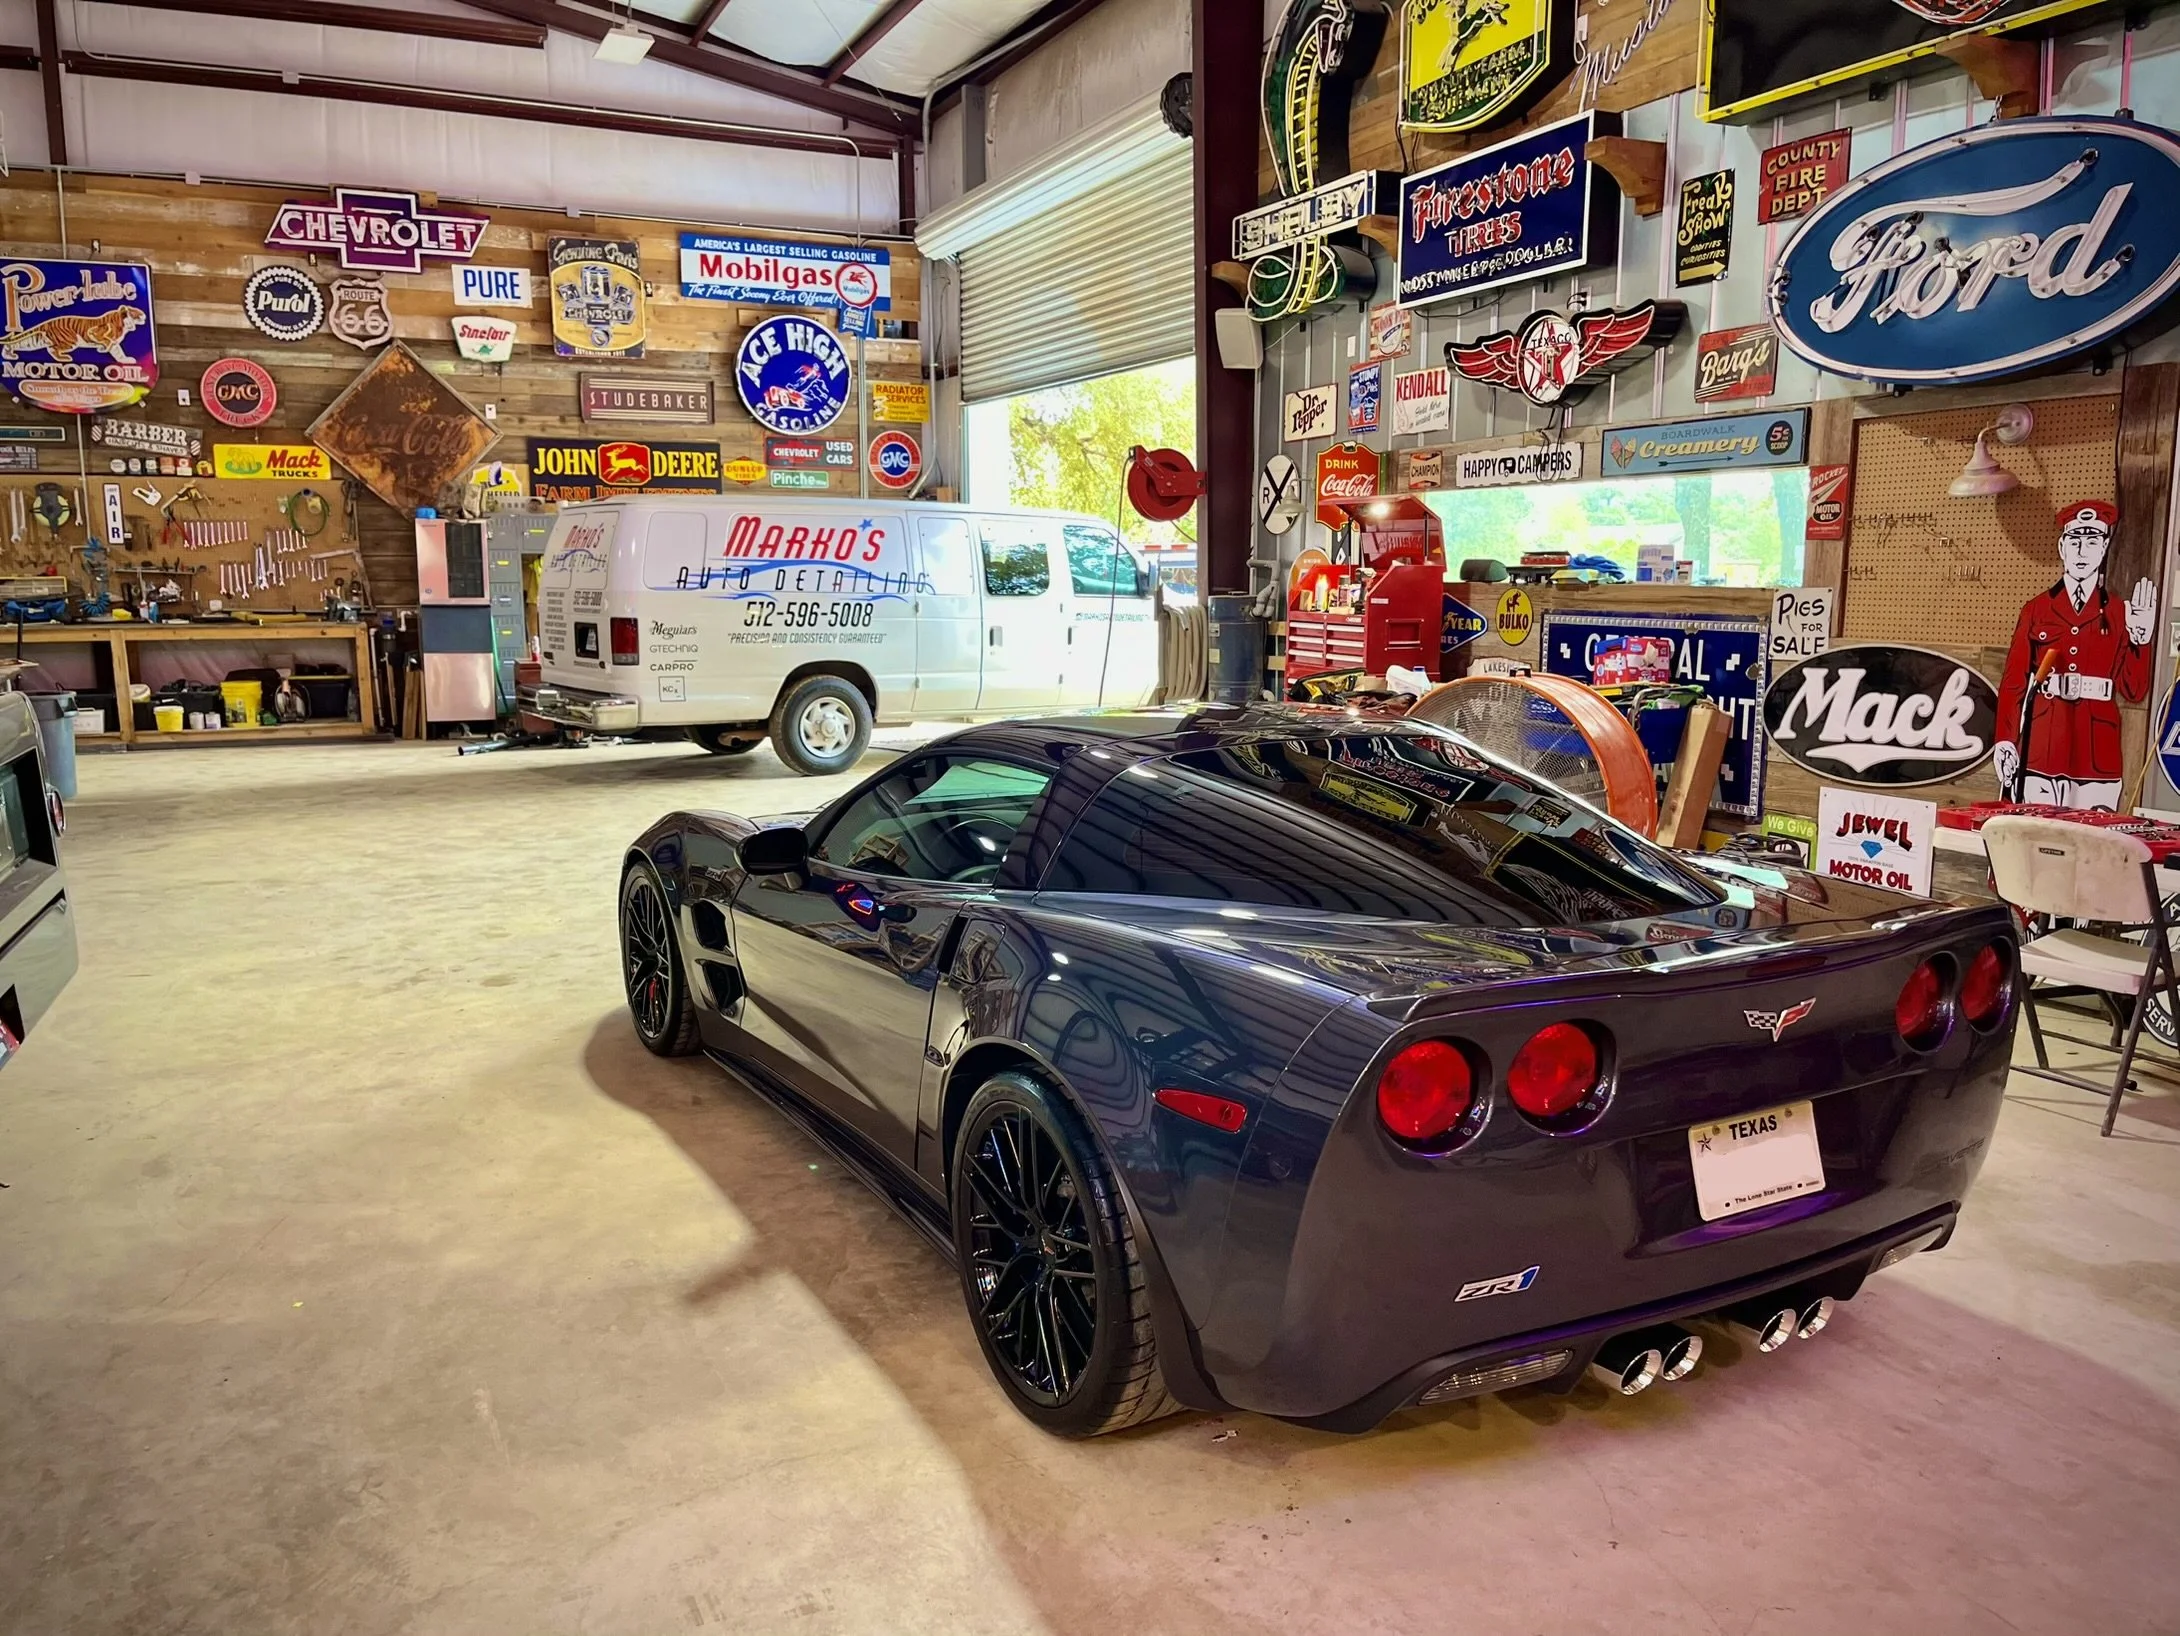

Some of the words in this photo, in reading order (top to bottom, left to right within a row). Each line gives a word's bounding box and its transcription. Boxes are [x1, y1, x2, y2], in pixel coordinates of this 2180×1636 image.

[1767, 140, 1841, 176] COUNTY
[1774, 164, 1827, 193] FIRE
[1412, 146, 1576, 245] Firestone
[1770, 187, 1828, 217] DEPT
[1241, 182, 1366, 251] SHELBY
[280, 211, 476, 251] CHEVROLET
[554, 240, 603, 265] Genuine
[694, 238, 741, 251] AMERICA'S
[744, 242, 786, 256] LARGEST
[789, 246, 827, 259] SELLING
[831, 250, 877, 262] GASOLINE
[1810, 150, 2134, 334] Ford
[604, 243, 638, 269] Parts
[1680, 250, 1726, 267] CURIOSITIES
[261, 278, 275, 288] THE
[274, 276, 292, 284] PURE
[700, 254, 832, 289] Mobilgas
[343, 289, 376, 300] ROUTE
[464, 270, 521, 299] PURE
[688, 283, 704, 295] The
[772, 290, 796, 304] Ever
[257, 290, 311, 313] Purol
[339, 303, 386, 335] 66
[567, 309, 628, 320] CHEVROLET
[459, 325, 511, 341] Sinclair
[1531, 332, 1572, 349] TEXACO
[741, 326, 782, 388] ACE
[785, 323, 847, 380] HIGH
[2, 361, 102, 380] MOTOR
[104, 365, 150, 382] OIL
[218, 383, 259, 400] GMC
[876, 385, 925, 396] RADIATOR
[1396, 369, 1448, 402] KENDALL
[590, 391, 708, 410] STUDEBAKER
[886, 395, 926, 405] SERVICES
[1302, 392, 1320, 415] Dr
[755, 397, 841, 430] GASOLINE
[1292, 399, 1328, 435] Pepper
[105, 418, 188, 446] BARBER
[1661, 424, 1736, 440] BOARDWALK
[155, 444, 185, 455] SHAVES
[773, 448, 819, 458] CHEVROLET
[826, 441, 854, 452] USED
[1639, 435, 1760, 459] Creamery
[1770, 441, 1788, 451] SCOOP
[266, 449, 323, 468] Mack
[534, 448, 596, 475] JOHN
[653, 452, 719, 478] DEERE
[726, 465, 763, 473] DUNLOP
[826, 455, 854, 465] CARS
[881, 452, 909, 468] GMC
[1325, 459, 1359, 469] DRINK
[1464, 458, 1497, 478] HAPPY
[1517, 450, 1572, 475] CAMPERS
[272, 470, 318, 478] TRUCKS
[773, 473, 815, 486] Pinche
[1411, 463, 1440, 478] CHAMPION
[1812, 467, 1845, 489] ROCKET
[535, 484, 591, 501] FARM
[1262, 487, 1270, 504] R
[109, 495, 120, 539] AIR
[1816, 503, 1841, 514] MOTOR
[1820, 513, 1834, 521] OIL
[723, 516, 885, 561] MARKO'S
[677, 566, 750, 589] AUTO
[775, 569, 926, 594] DETAILING
[744, 601, 874, 628] 512-596-5008
[1777, 593, 1825, 628] PIGS
[1498, 613, 1529, 630] BULKO
[1801, 622, 1823, 633] FOR
[649, 644, 698, 653] GTECHNIQ
[772, 632, 787, 644] AND
[789, 632, 838, 644] CONSISTENCY
[1773, 636, 1825, 655] SALE
[649, 663, 694, 671] CARPRO
[1774, 667, 1983, 762] Mack
[1768, 815, 1785, 831] We
[1787, 819, 1815, 837] Give
[1836, 812, 1913, 852] JEWEL
[1829, 859, 1883, 885] MOTOR
[1886, 871, 1913, 891] OIL
[1729, 1114, 1778, 1141] TEXAS
[1735, 1196, 1746, 1204] The
[1748, 1192, 1762, 1201] Lone
[1763, 1188, 1776, 1197] Star
[1777, 1184, 1793, 1193] State
[1458, 1267, 1540, 1300] ZR1
